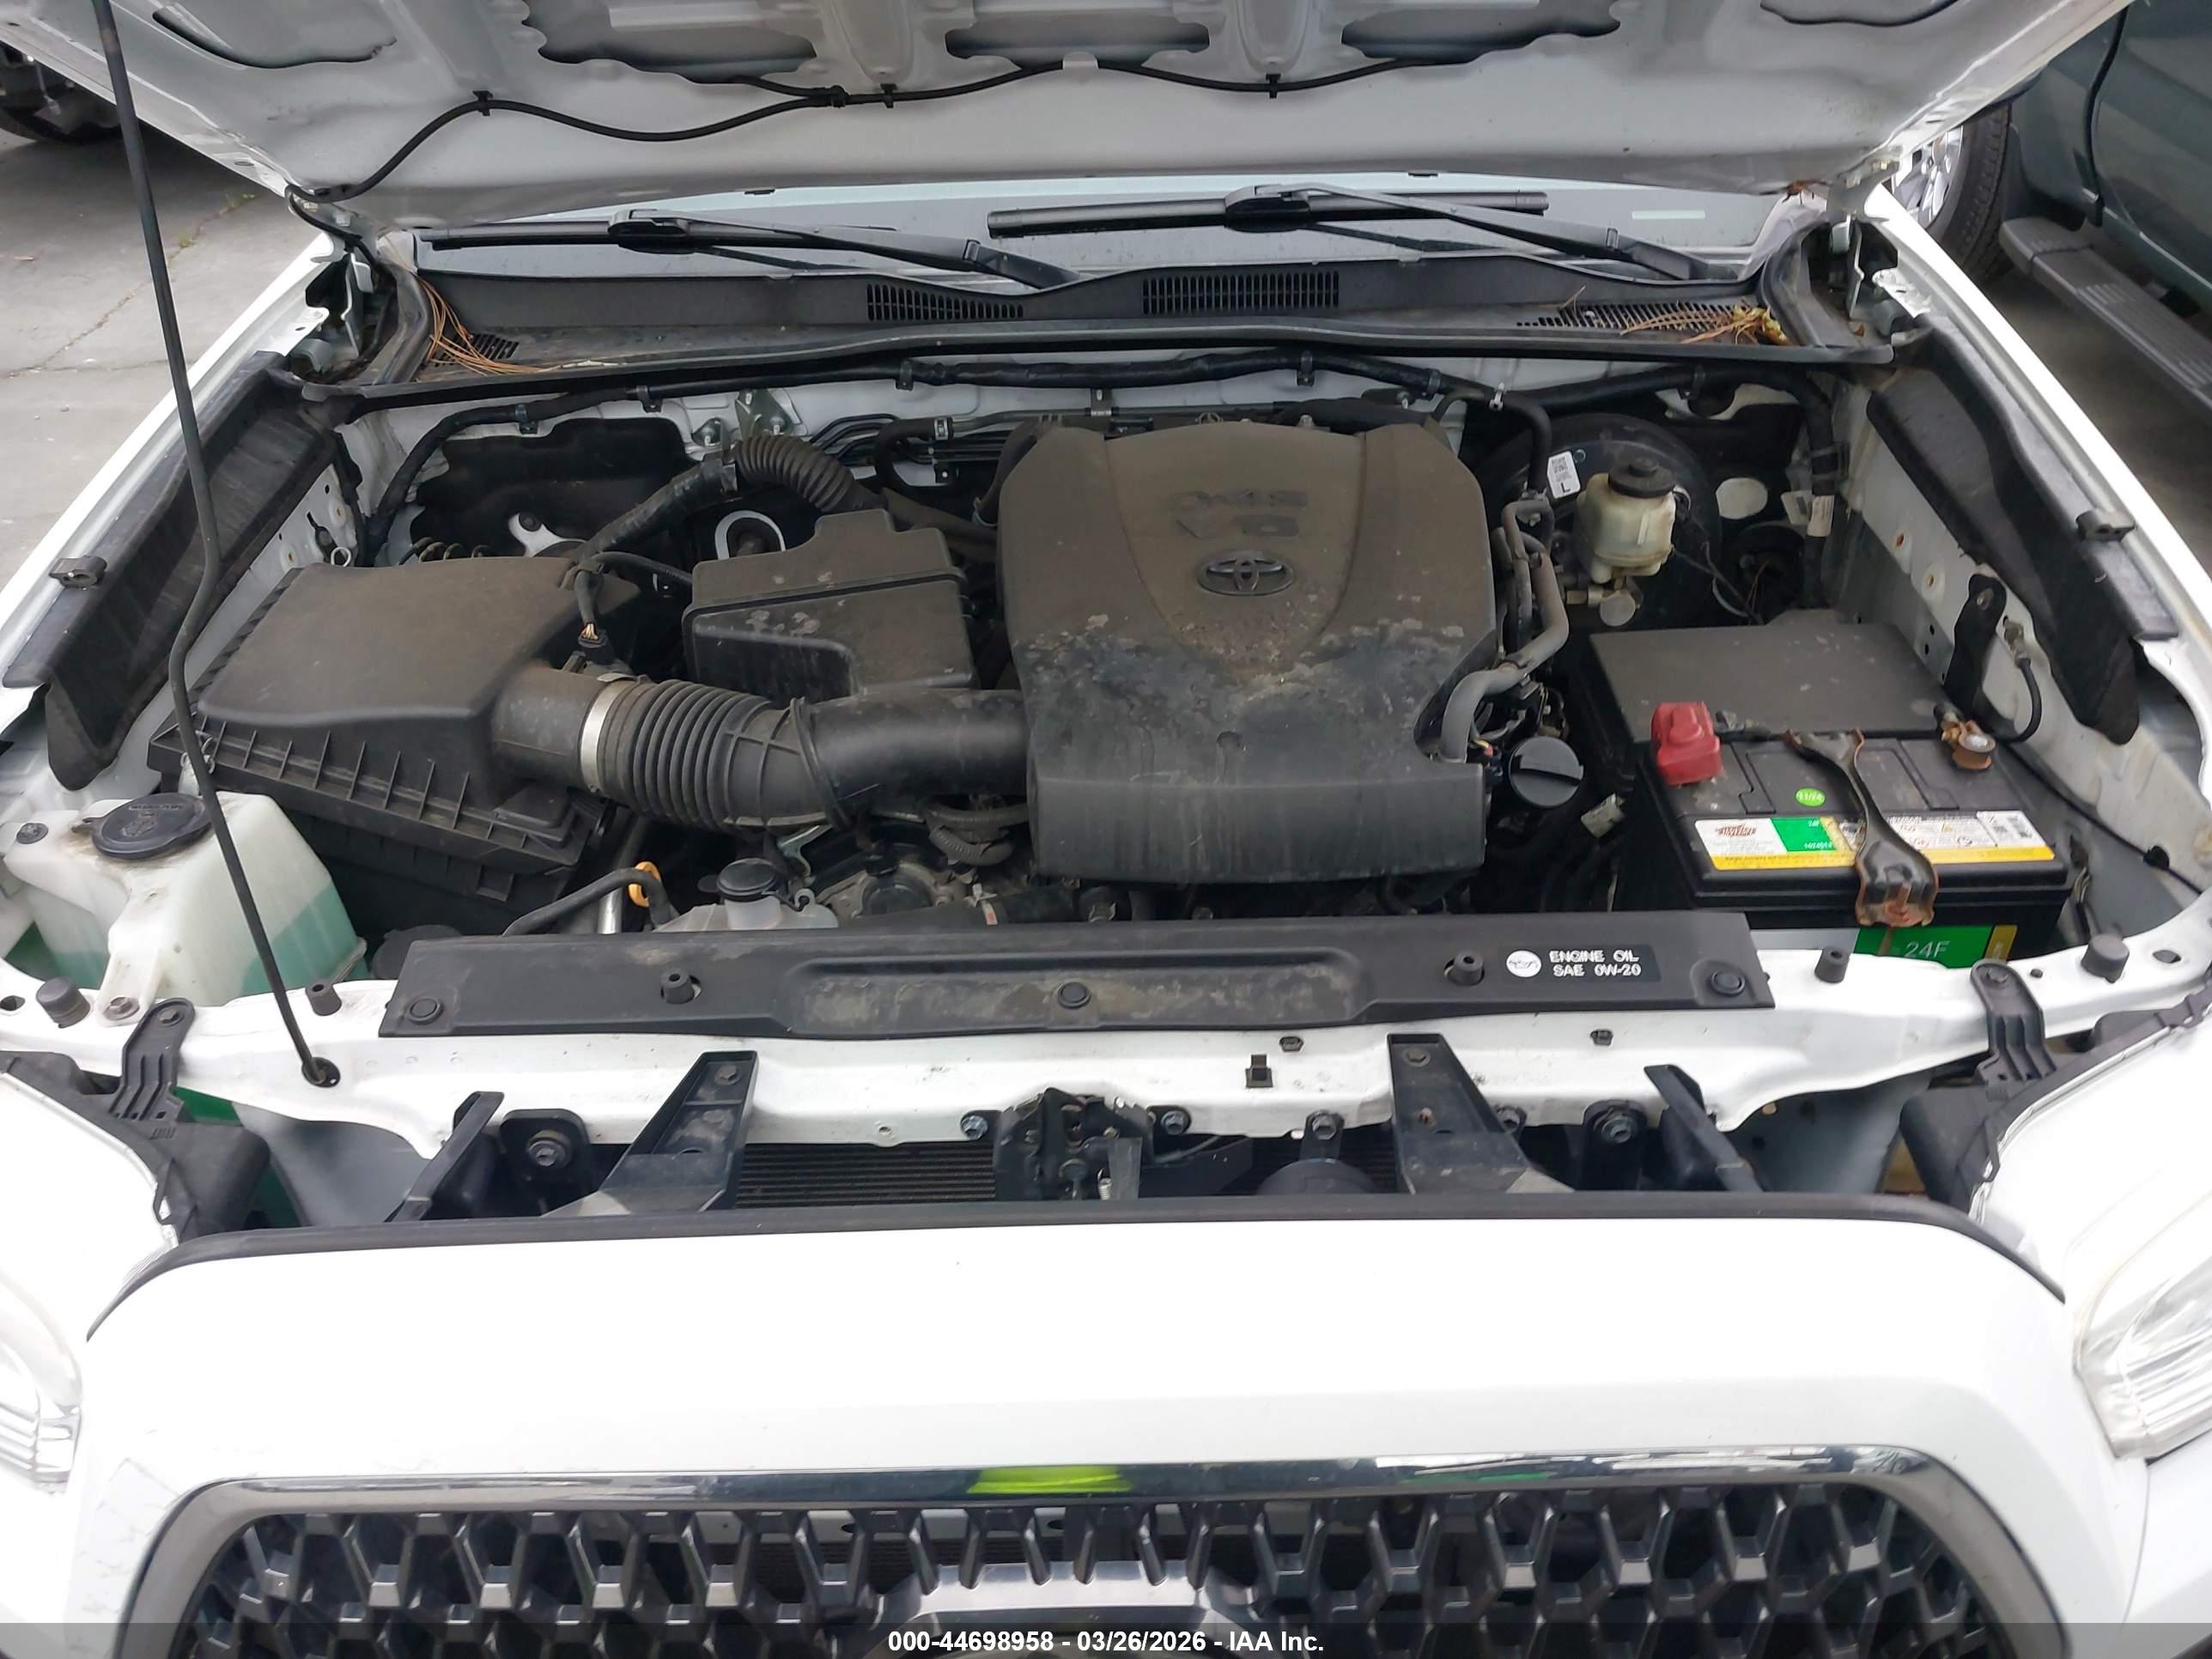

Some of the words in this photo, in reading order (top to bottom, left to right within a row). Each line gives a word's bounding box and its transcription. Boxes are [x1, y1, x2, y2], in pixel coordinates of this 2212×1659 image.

[1560, 482, 1571, 493] L
[1548, 950, 1605, 963] ENGINE
[1613, 949, 1640, 962] OIL
[1905, 940, 1950, 958] 24F
[1553, 964, 1585, 977] SAE
[1594, 963, 1642, 976] 0W-20
